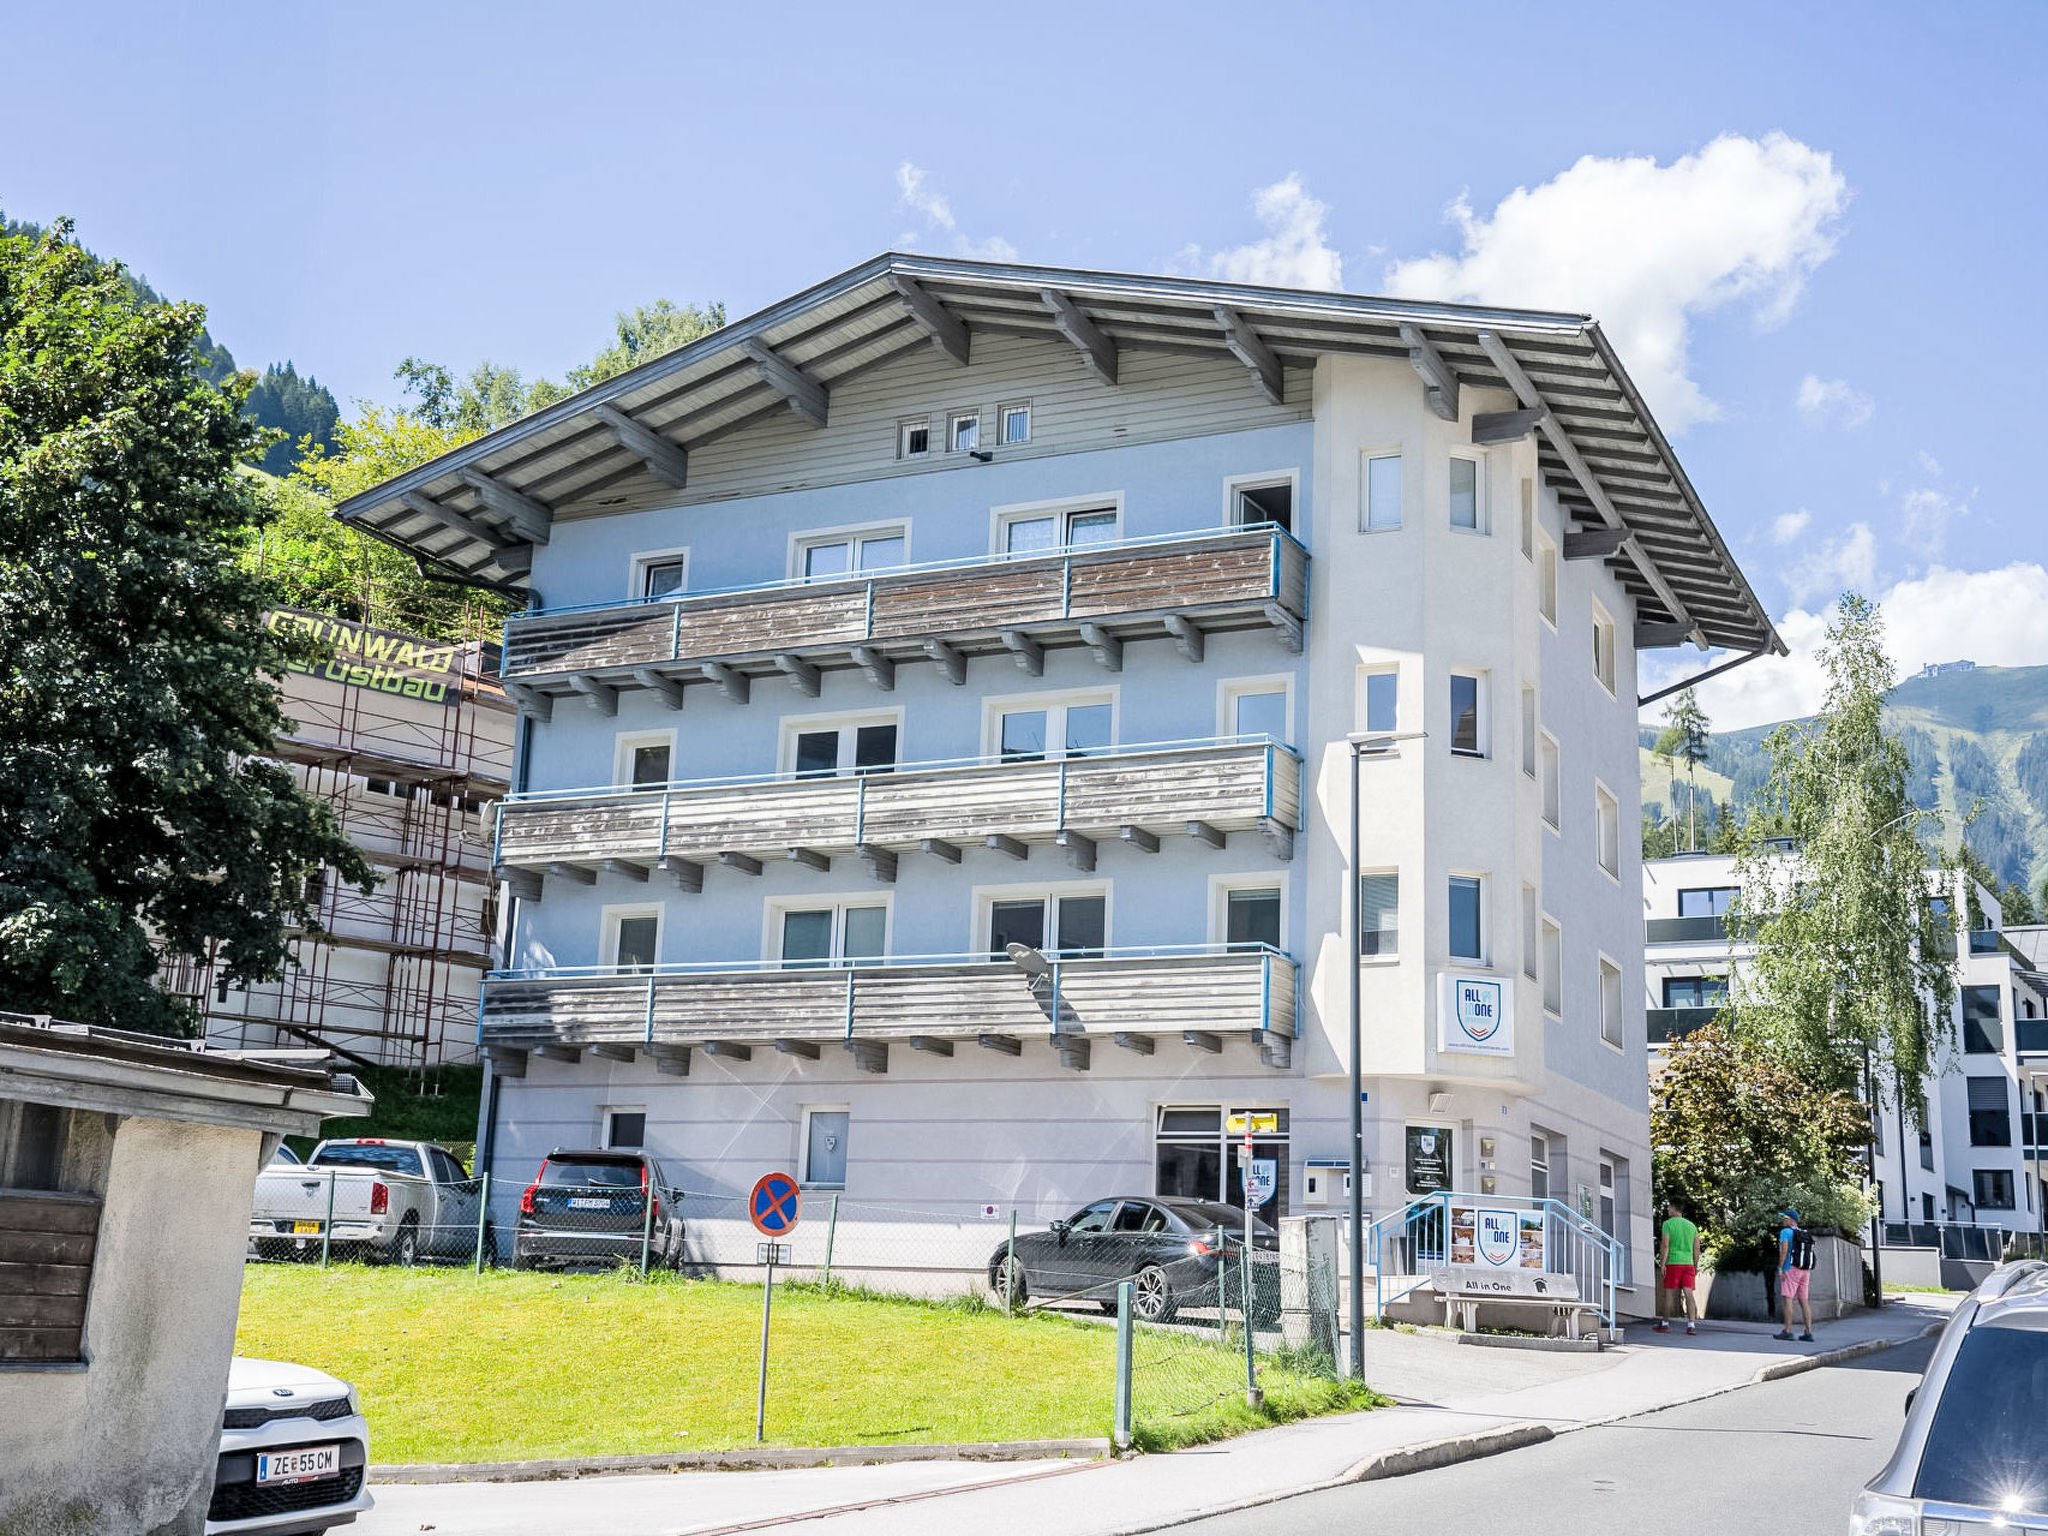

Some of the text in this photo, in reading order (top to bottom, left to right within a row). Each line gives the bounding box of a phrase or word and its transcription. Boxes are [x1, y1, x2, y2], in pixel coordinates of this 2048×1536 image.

[286, 655, 448, 702] erüstbau
[1465, 988, 1481, 1002] ALL
[1475, 1003, 1492, 1017] ONE
[1252, 1164, 1261, 1175] LL
[1485, 1217, 1499, 1230] ALL
[1494, 1231, 1510, 1243] ONE
[1465, 1280, 1512, 1291] All in One
[274, 1450, 332, 1475] ZE 55 CM
